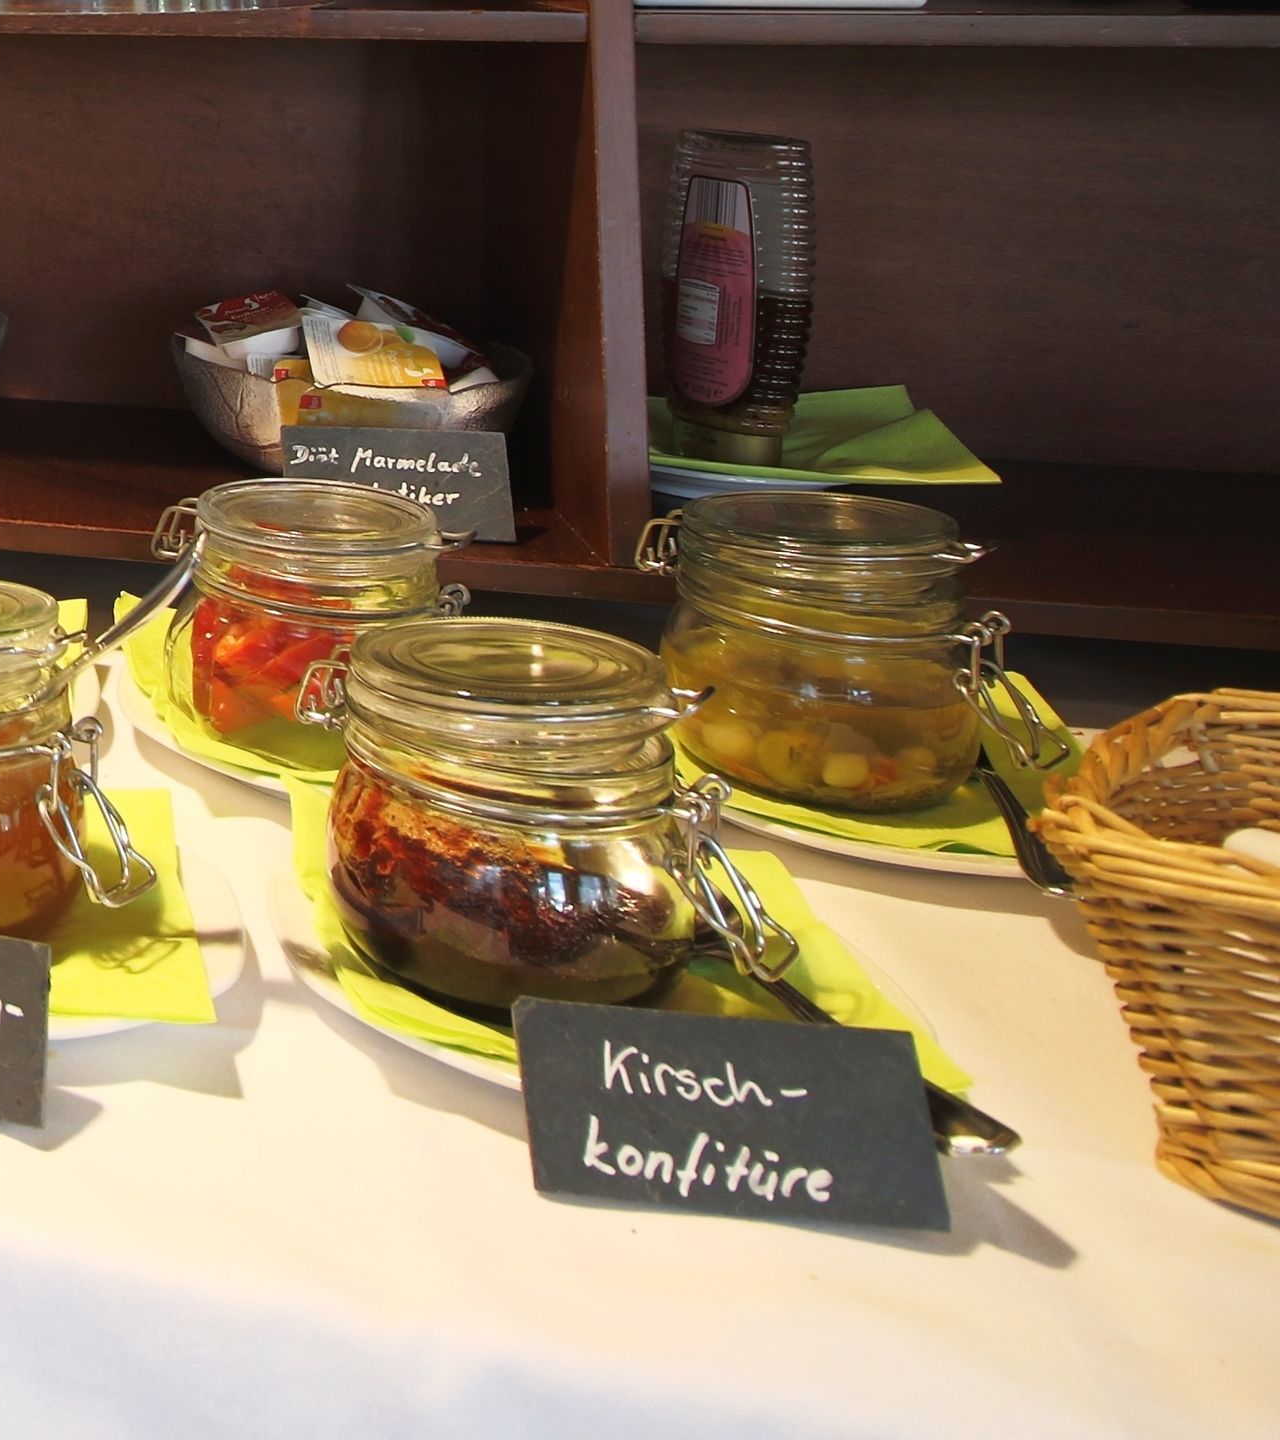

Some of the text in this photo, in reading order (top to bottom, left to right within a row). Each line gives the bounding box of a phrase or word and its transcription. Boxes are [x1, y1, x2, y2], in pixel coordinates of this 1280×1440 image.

[290, 444, 482, 478] Diät Marmelade
[603, 1039, 808, 1108] Kirsch-
[583, 1114, 835, 1203] konfitüre
